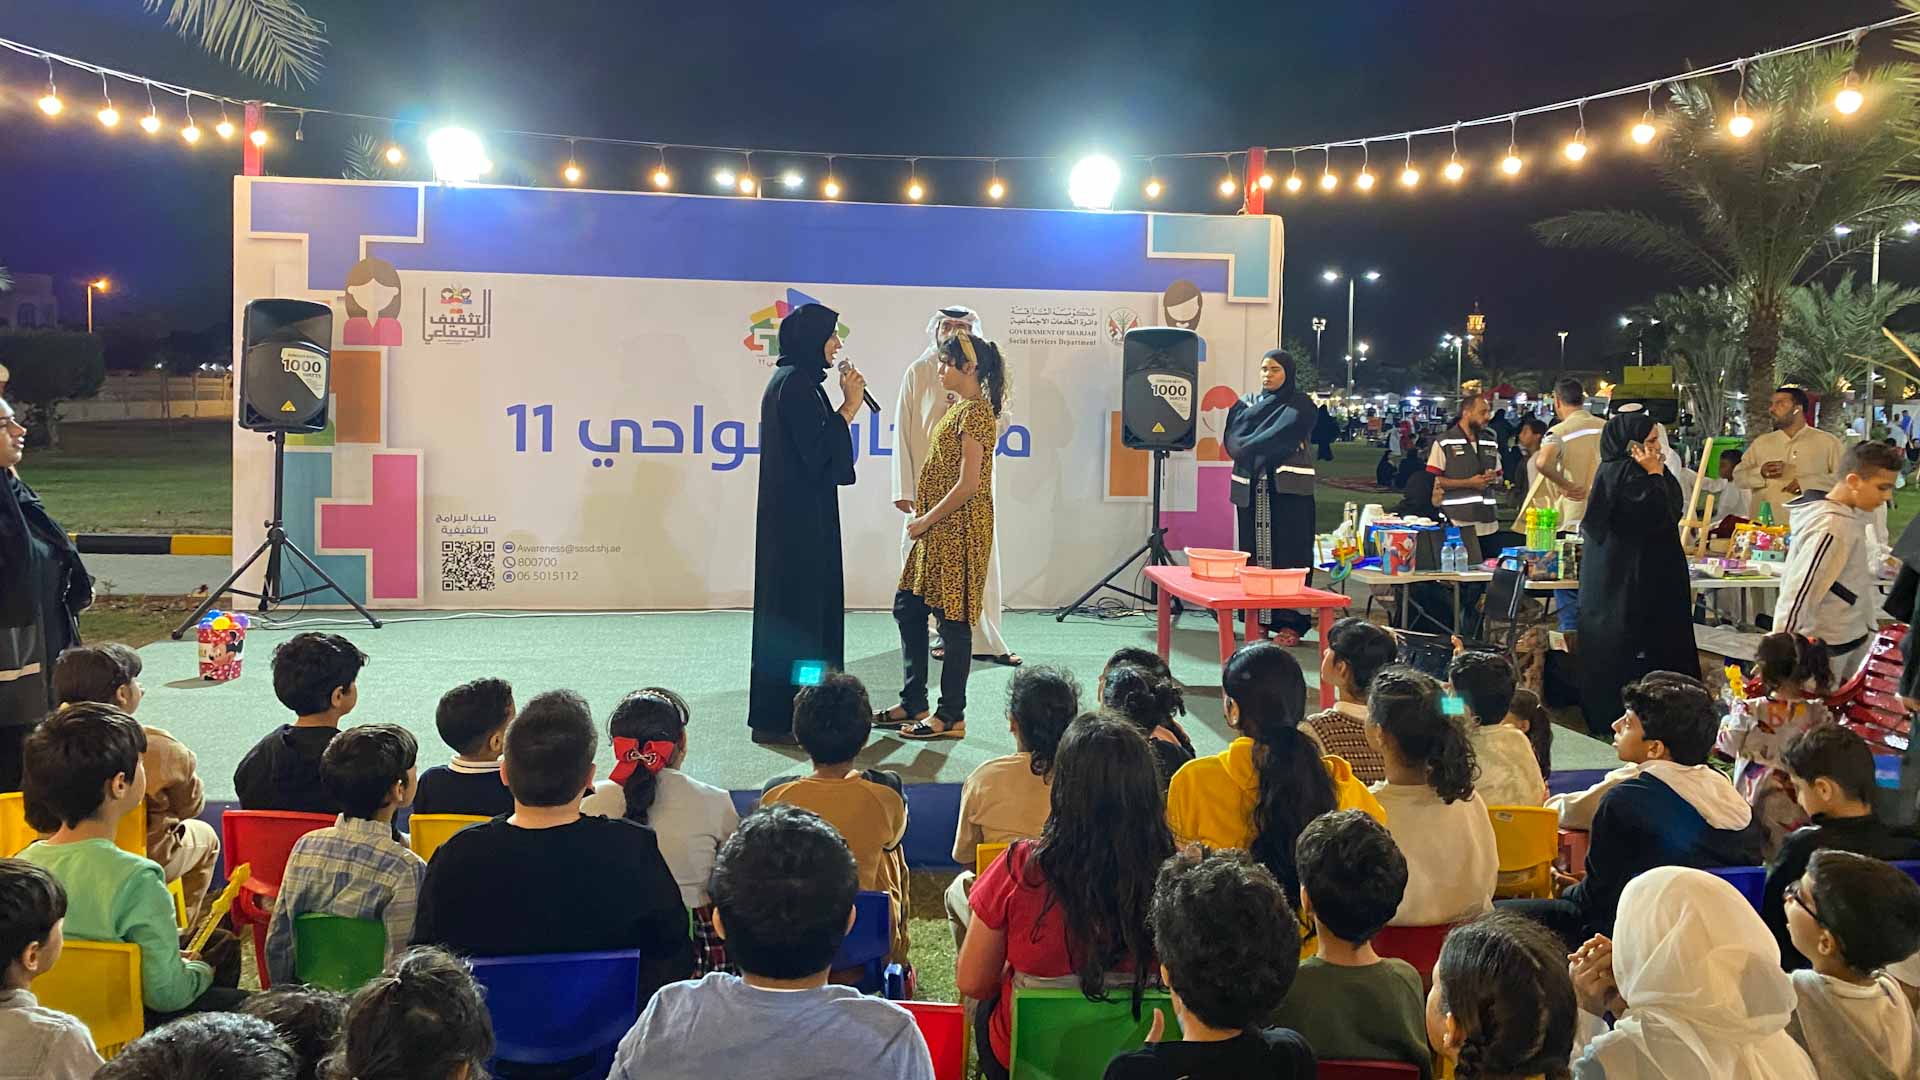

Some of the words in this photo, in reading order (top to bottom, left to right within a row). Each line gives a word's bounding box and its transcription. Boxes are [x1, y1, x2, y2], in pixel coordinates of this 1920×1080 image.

[1009, 328, 1055, 336] GOVERNMENT
[1066, 329, 1097, 337] SHARJAH
[1009, 337, 1028, 345] Social
[1059, 338, 1097, 347] Department
[283, 360, 321, 373] 1000
[1152, 385, 1187, 396] 1000
[506, 403, 553, 452] 11
[435, 513, 469, 524] البرامج
[471, 513, 497, 524] طلب
[517, 557, 557, 568] 800700
[517, 571, 530, 581] 06
[532, 571, 579, 581] 5015112
